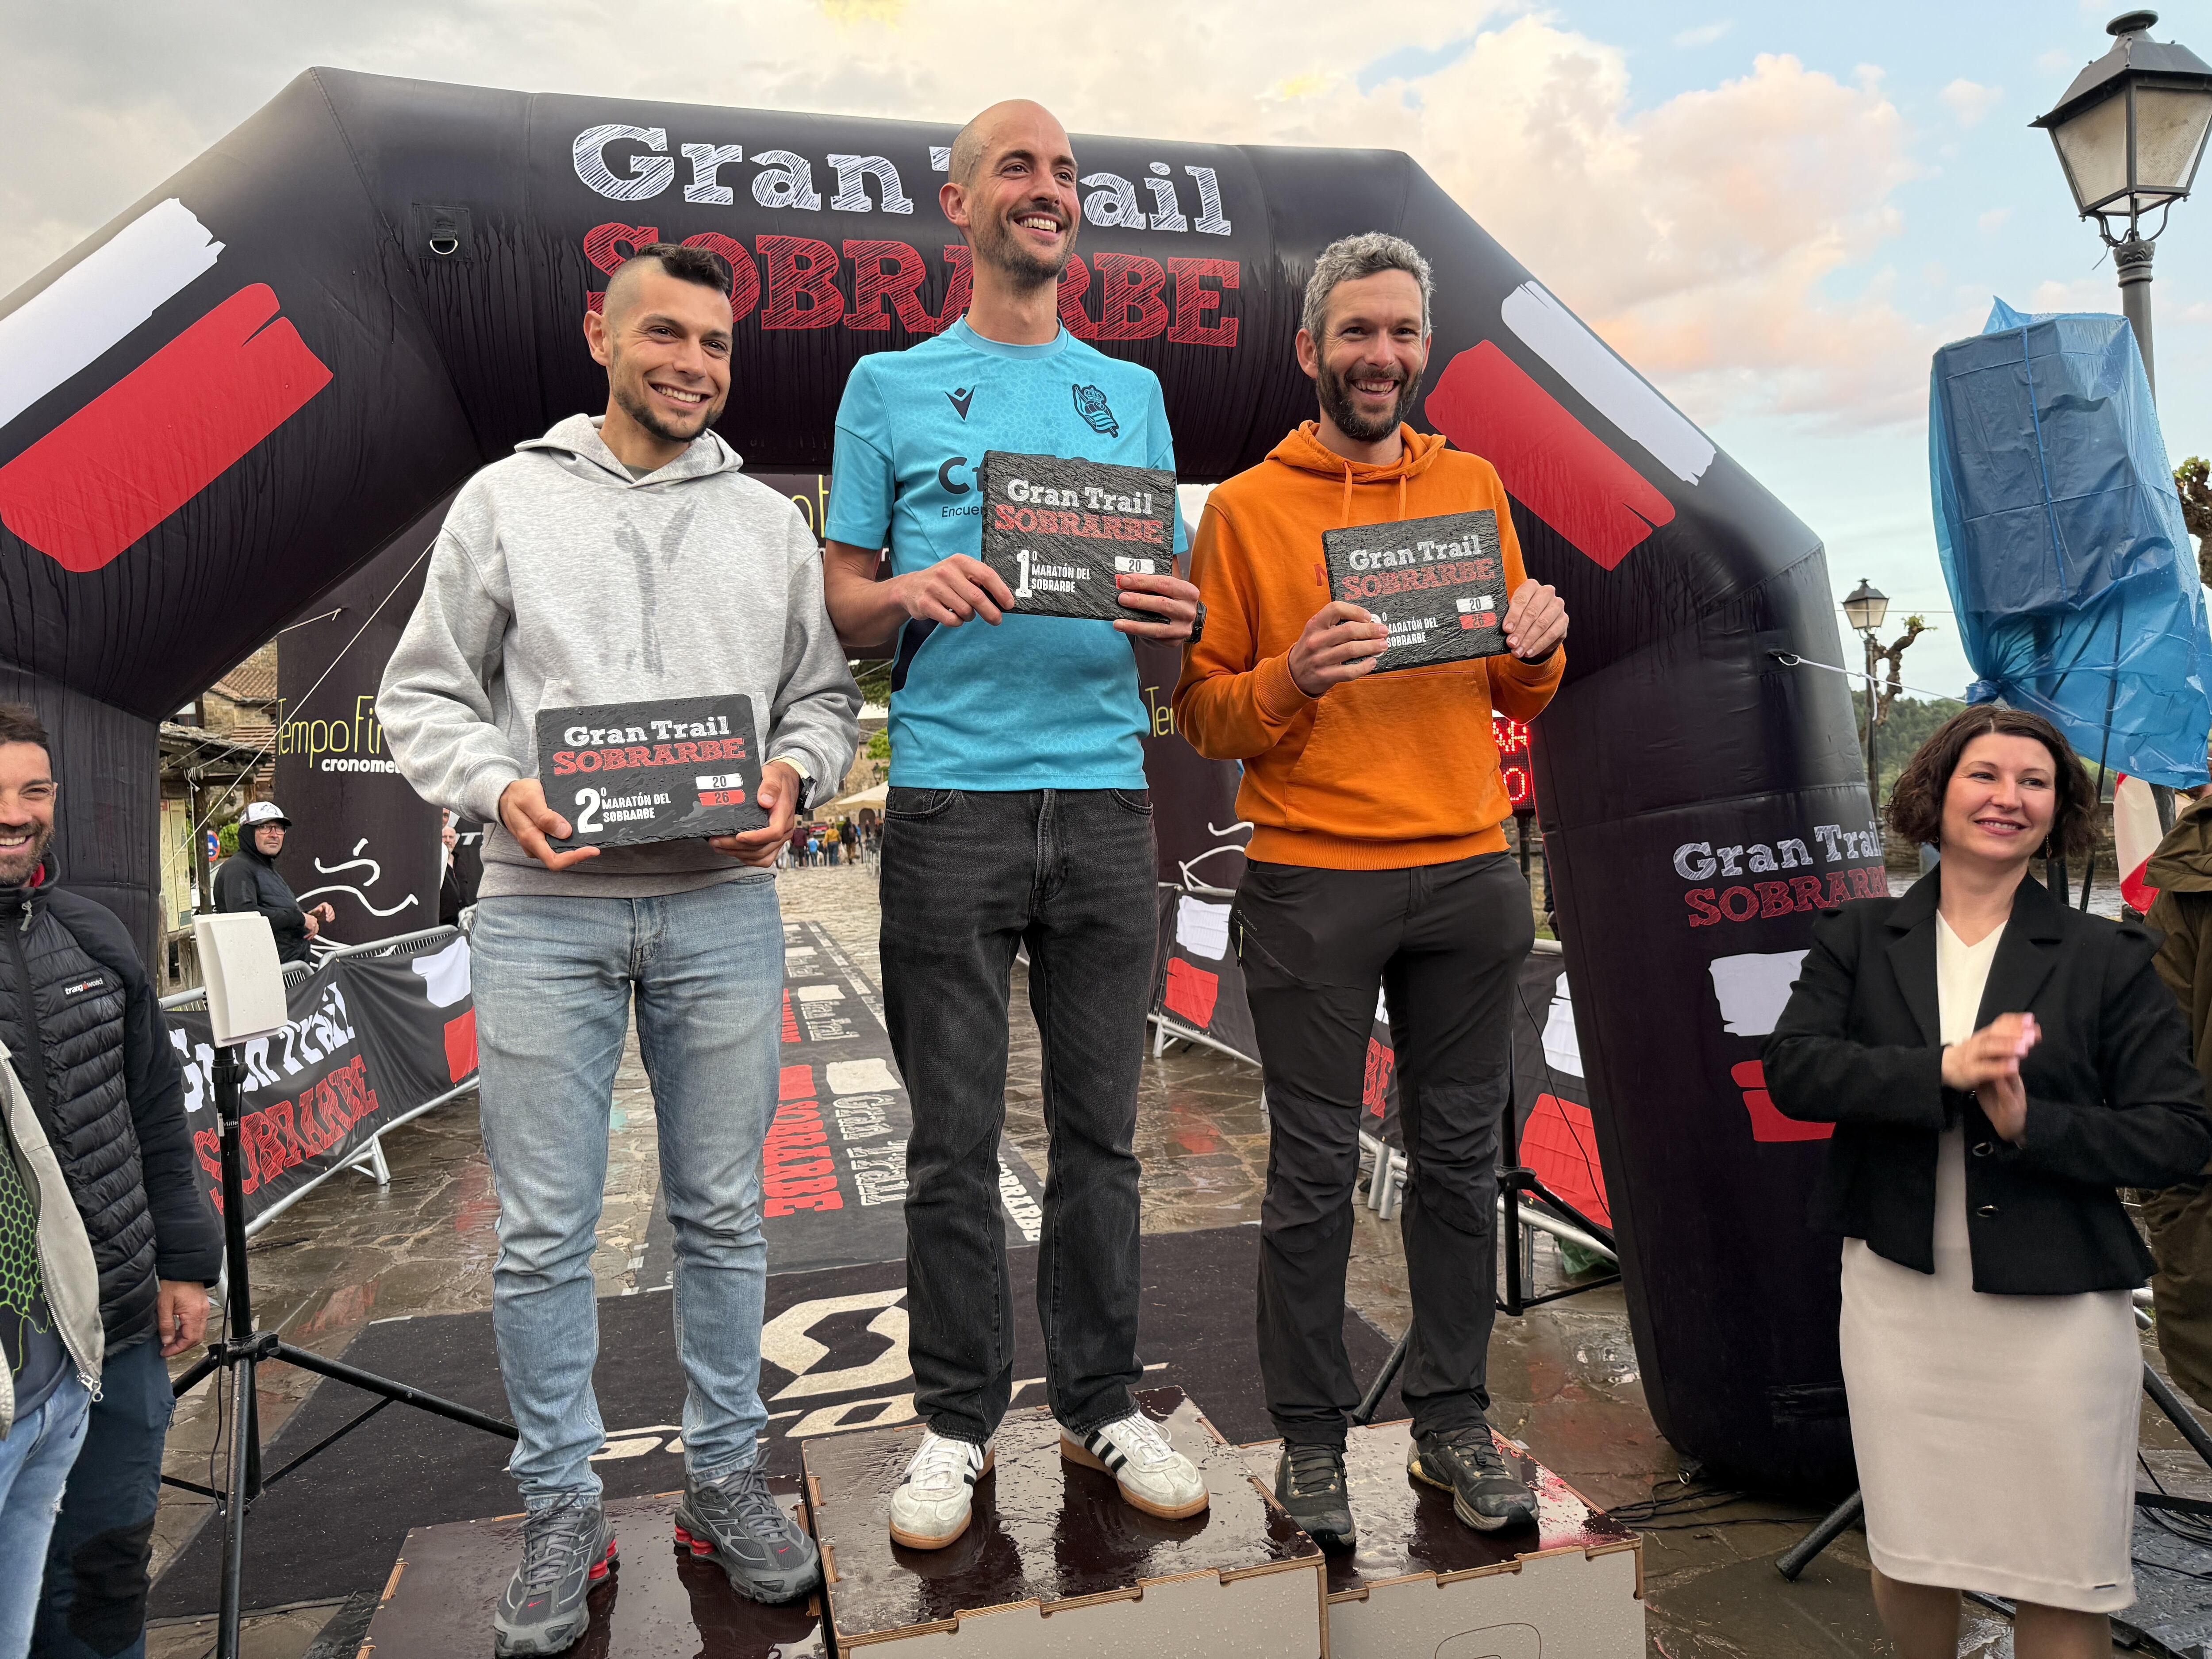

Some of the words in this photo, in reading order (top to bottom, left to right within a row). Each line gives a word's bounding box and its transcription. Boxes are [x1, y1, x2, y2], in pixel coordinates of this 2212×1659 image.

[572, 124, 914, 215] Gran
[1008, 479, 1079, 508] Gran
[1084, 487, 1152, 515] Trail
[942, 506, 983, 517] Encue
[995, 504, 1164, 545] SOBRARBE
[1349, 549, 1416, 570] Gran
[1417, 535, 1482, 561] Trail
[1032, 563, 1074, 579] MARATÓN
[1076, 568, 1091, 580] DEL
[1129, 559, 1141, 572] 20
[1031, 578, 1076, 593] SOBRARBE
[1342, 558, 1495, 600] SOBRARBE
[1469, 598, 1481, 611] 20
[1424, 617, 1438, 629] DEL
[1386, 632, 1427, 648] SOBRARBE
[564, 725, 648, 747] Gran
[650, 716, 731, 741] Trail
[553, 737, 746, 776] SOBRARBE
[712, 776, 727, 787] 20
[602, 791, 652, 810] MARATÓN
[654, 793, 671, 804] DEL
[714, 791, 729, 803] 26
[603, 807, 656, 822] SOBRARBE
[1673, 838, 1813, 881] Gran
[1814, 821, 1882, 862] Trail
[762, 1100, 843, 1217] SOBRARBE
